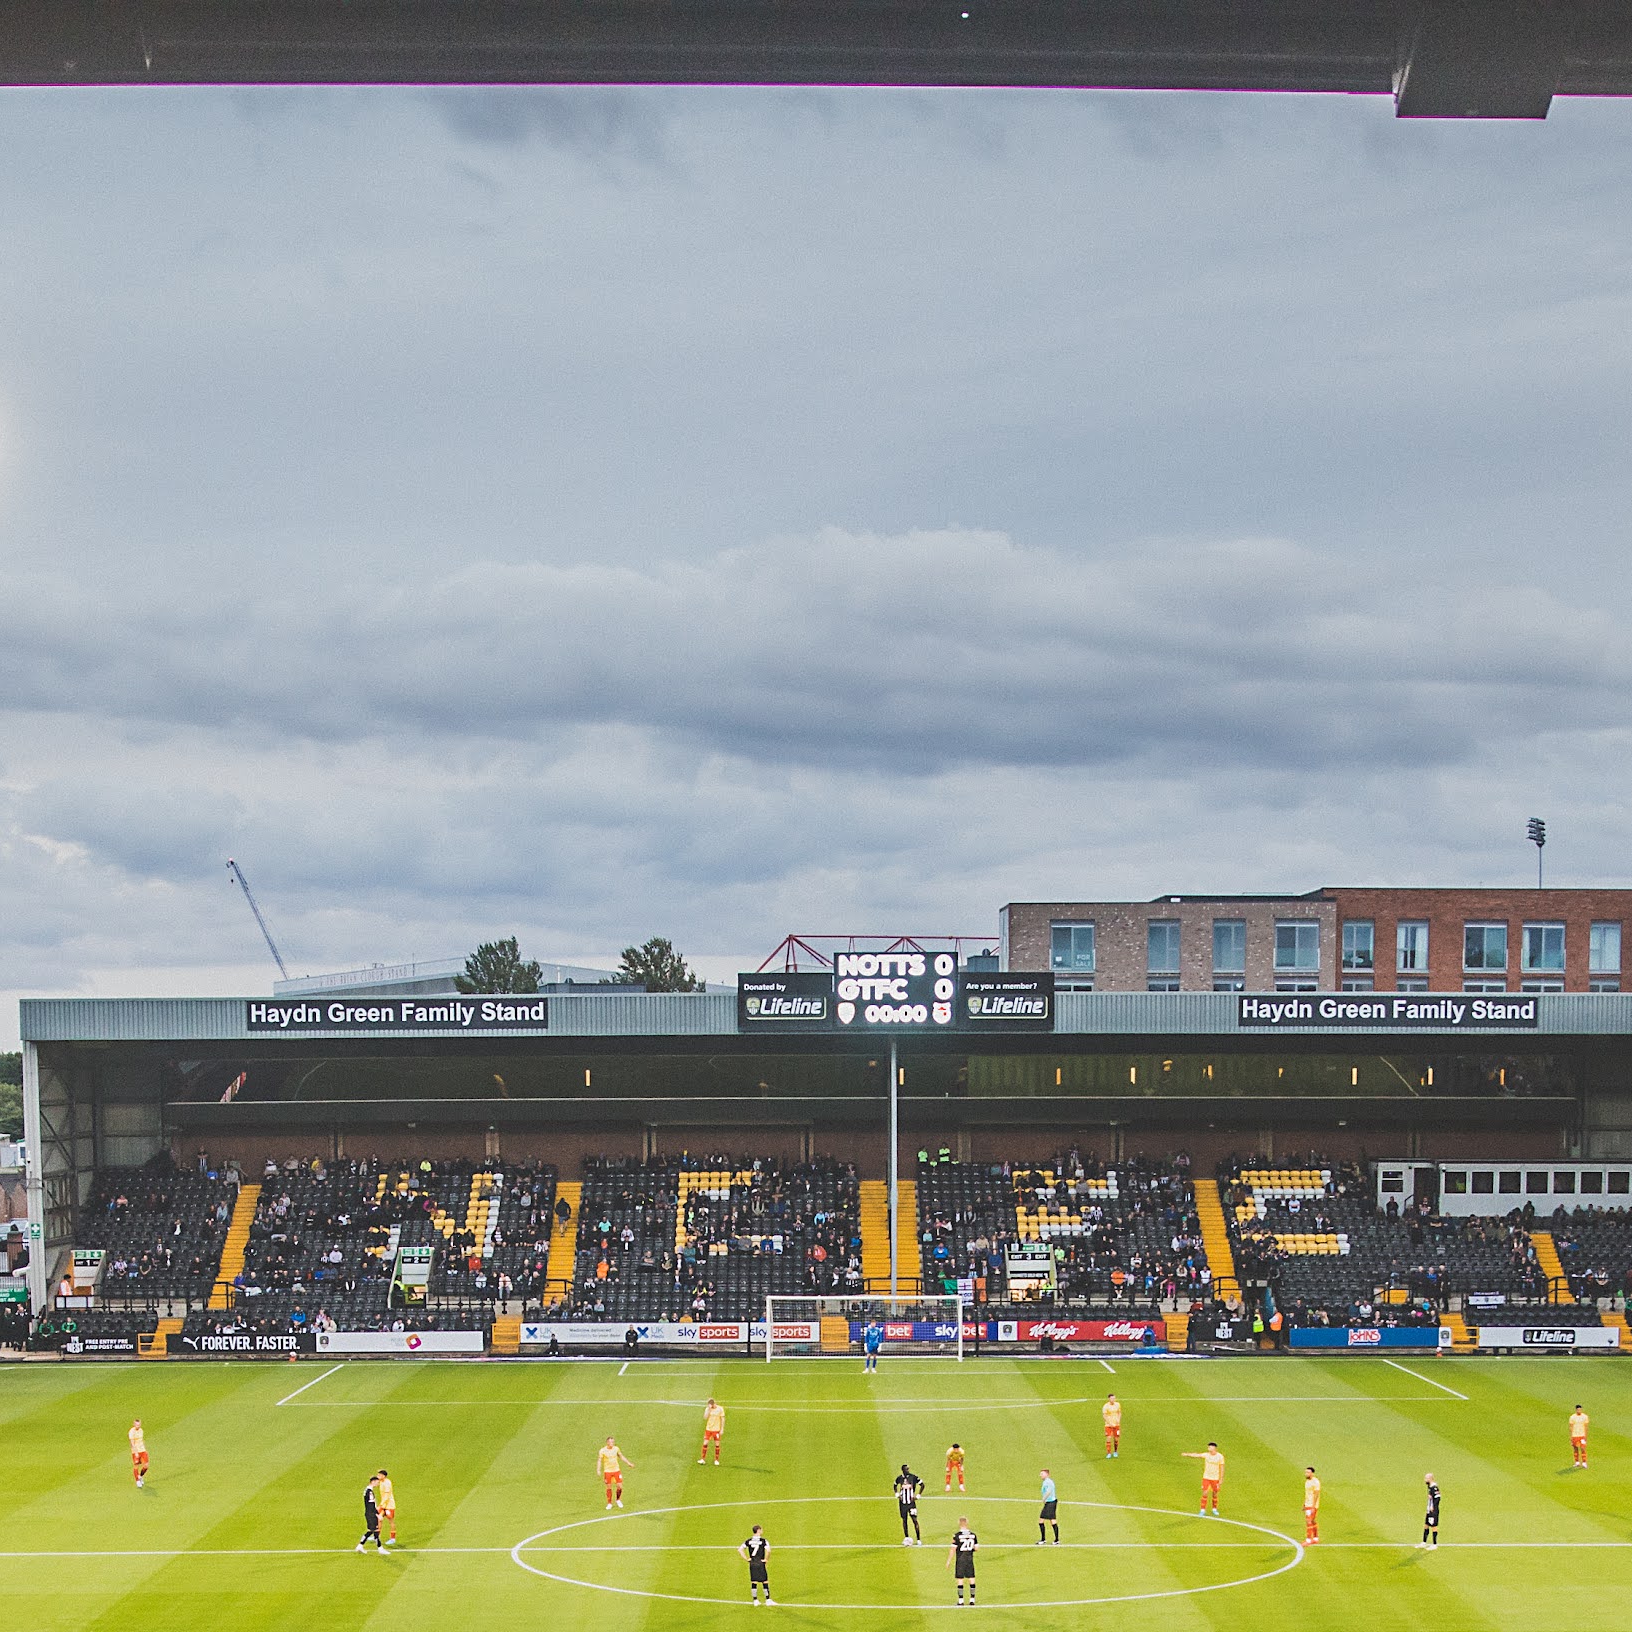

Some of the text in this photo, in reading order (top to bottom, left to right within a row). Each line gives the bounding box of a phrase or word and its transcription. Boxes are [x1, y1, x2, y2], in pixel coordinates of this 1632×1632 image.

[837, 953, 954, 976] NOTTS 0
[743, 982, 786, 992] Donated by
[837, 978, 953, 1000] GTFC 0
[965, 982, 979, 990] Are
[979, 984, 994, 992] you
[1002, 982, 1038, 990] member?
[760, 997, 822, 1016] Lifeline
[981, 996, 1043, 1015] Lifeline
[1241, 998, 1535, 1024] Haydn Green Family Stand
[251, 1002, 545, 1028] Haydn Green Family Stand
[864, 1004, 928, 1023] 00:00
[413, 1256, 419, 1264] 2
[650, 1326, 665, 1334] UK
[677, 1326, 738, 1339] sky sports
[750, 1326, 810, 1338] sky sports
[887, 1324, 911, 1336] bet
[935, 1324, 957, 1340] sky
[1029, 1322, 1079, 1340] Kellogg's
[1532, 1330, 1574, 1343] Lifeline
[67, 1342, 83, 1353] NEST
[201, 1336, 301, 1350] FOREVER. FASTER.
[751, 1544, 759, 1556] 7
[959, 1538, 975, 1551] 20
